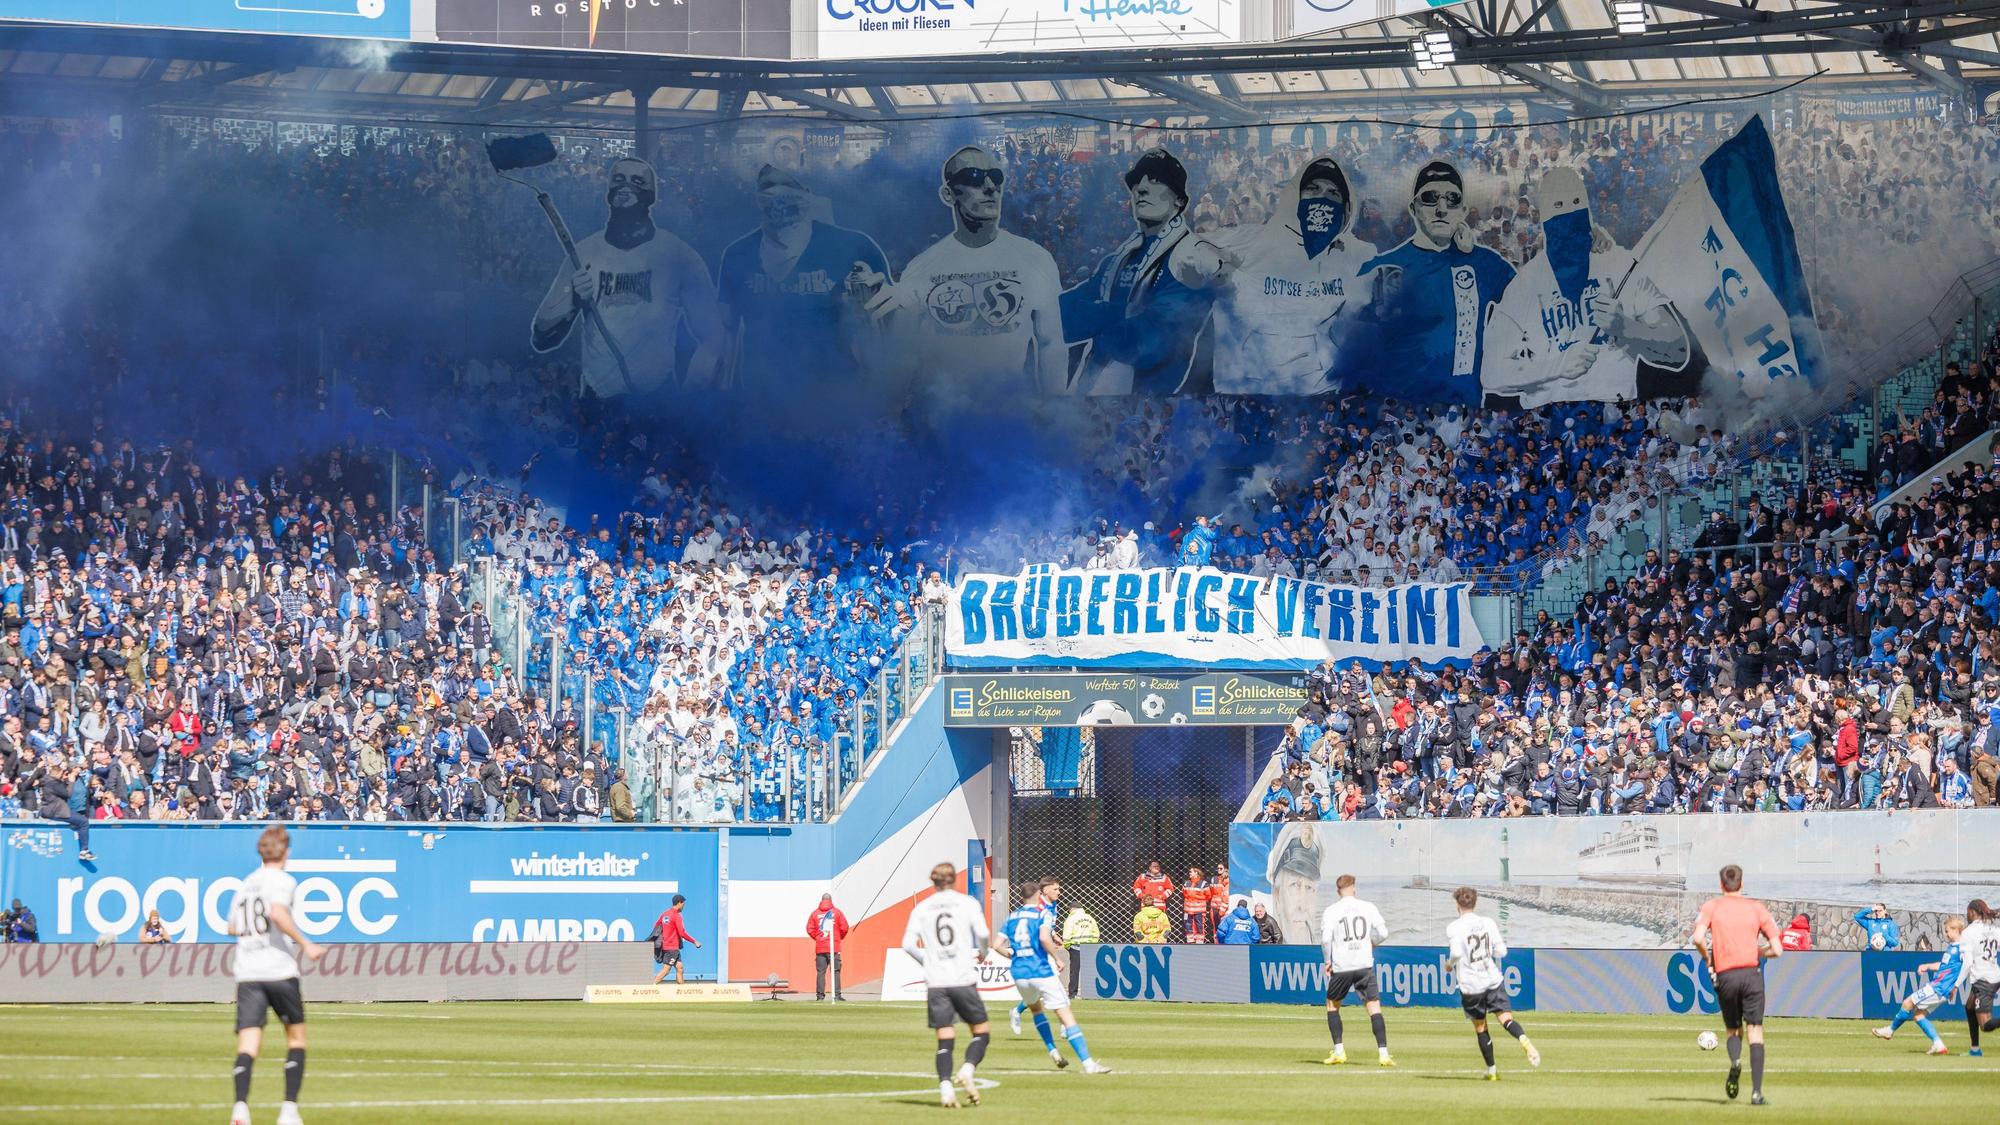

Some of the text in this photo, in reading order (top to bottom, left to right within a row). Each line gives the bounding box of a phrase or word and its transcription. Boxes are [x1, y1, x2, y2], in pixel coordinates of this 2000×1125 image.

[859, 15, 950, 31] Ideen mit Fliesen
[1264, 276, 1302, 297] OSTSEE
[960, 563, 1469, 648] BRÜDERLICH VEREINT
[978, 680, 1070, 706] Schlickeisen
[1122, 679, 1136, 690] 50
[1150, 679, 1181, 690] Rostock
[978, 705, 1061, 721] aus Liebe zur Region
[1235, 703, 1256, 715] Liebe
[1259, 706, 1274, 715] zur
[57, 859, 399, 944] rogaec
[237, 896, 270, 936] 18
[936, 912, 954, 946] 6
[1339, 916, 1367, 942] 10
[1014, 919, 1030, 948] 4
[1467, 932, 1490, 963] 21
[1096, 945, 1172, 1000] SSN
